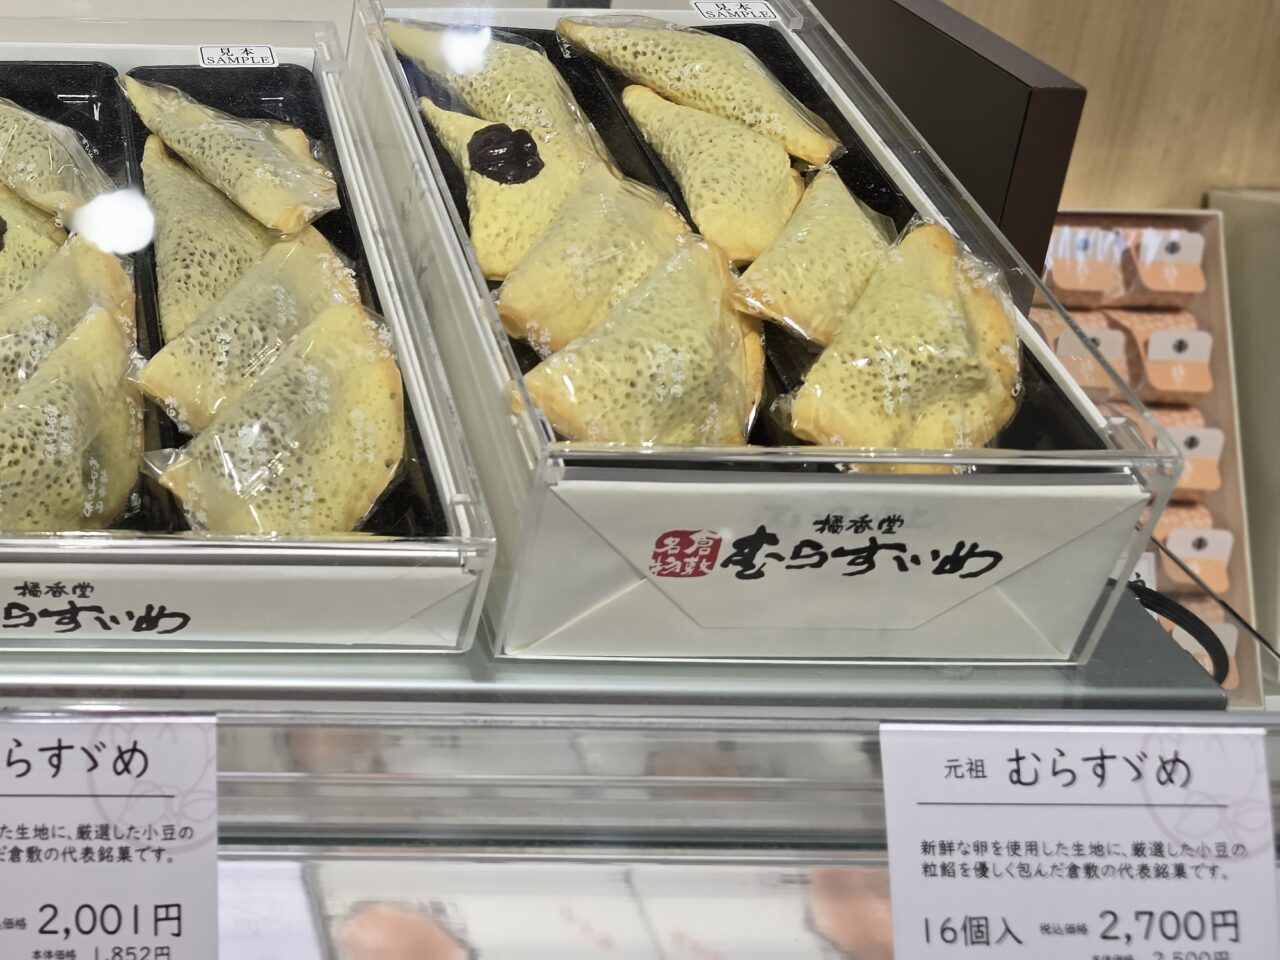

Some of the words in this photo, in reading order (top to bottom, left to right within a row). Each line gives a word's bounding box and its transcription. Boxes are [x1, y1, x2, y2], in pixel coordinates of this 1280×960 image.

[705, 10, 772, 18] SAMPLE
[206, 56, 270, 64] SAMPLE
[220, 47, 255, 56] 見本
[945, 758, 987, 778] 元祖
[1008, 748, 1191, 787] むらすゞめ
[920, 839, 1247, 860] 新鮮な卵を使用した生地に、厳選した小豆の
[920, 861, 1231, 881] 粒餡を優しく包んだ倉敷の代表銘菓です。
[38, 904, 181, 939] 2,001円
[925, 916, 1023, 946] 16個入
[1100, 910, 1239, 944] 2,700円
